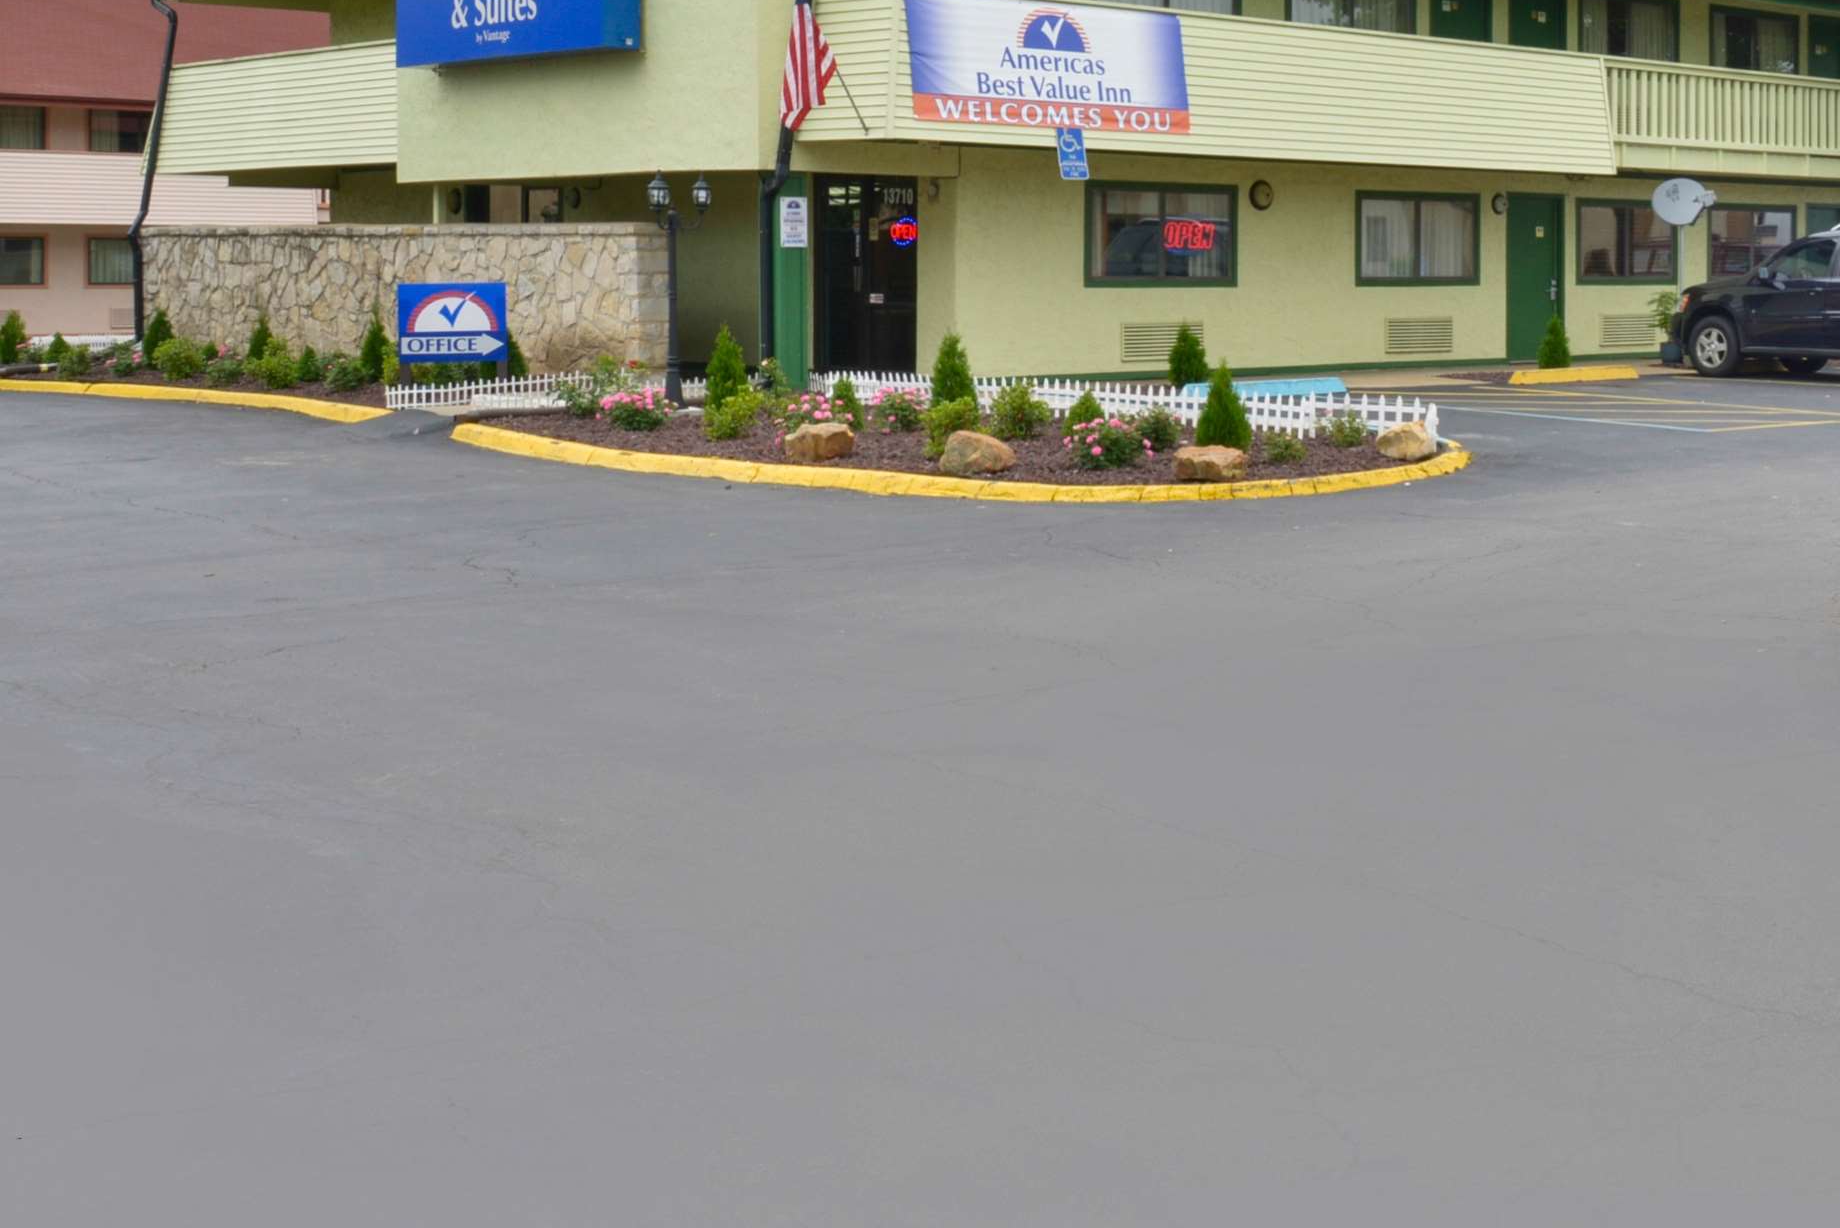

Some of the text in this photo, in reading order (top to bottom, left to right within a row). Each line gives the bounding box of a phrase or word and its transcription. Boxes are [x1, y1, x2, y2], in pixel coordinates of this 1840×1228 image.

[483, 30, 511, 44] Vantage
[1000, 46, 1106, 76] Americas
[976, 72, 1132, 104] Best Value Inn
[933, 97, 1171, 132] WELCOMES YOU
[889, 222, 918, 241] OPEN
[1163, 220, 1216, 251] OPEN
[407, 337, 478, 353] OFFICE
